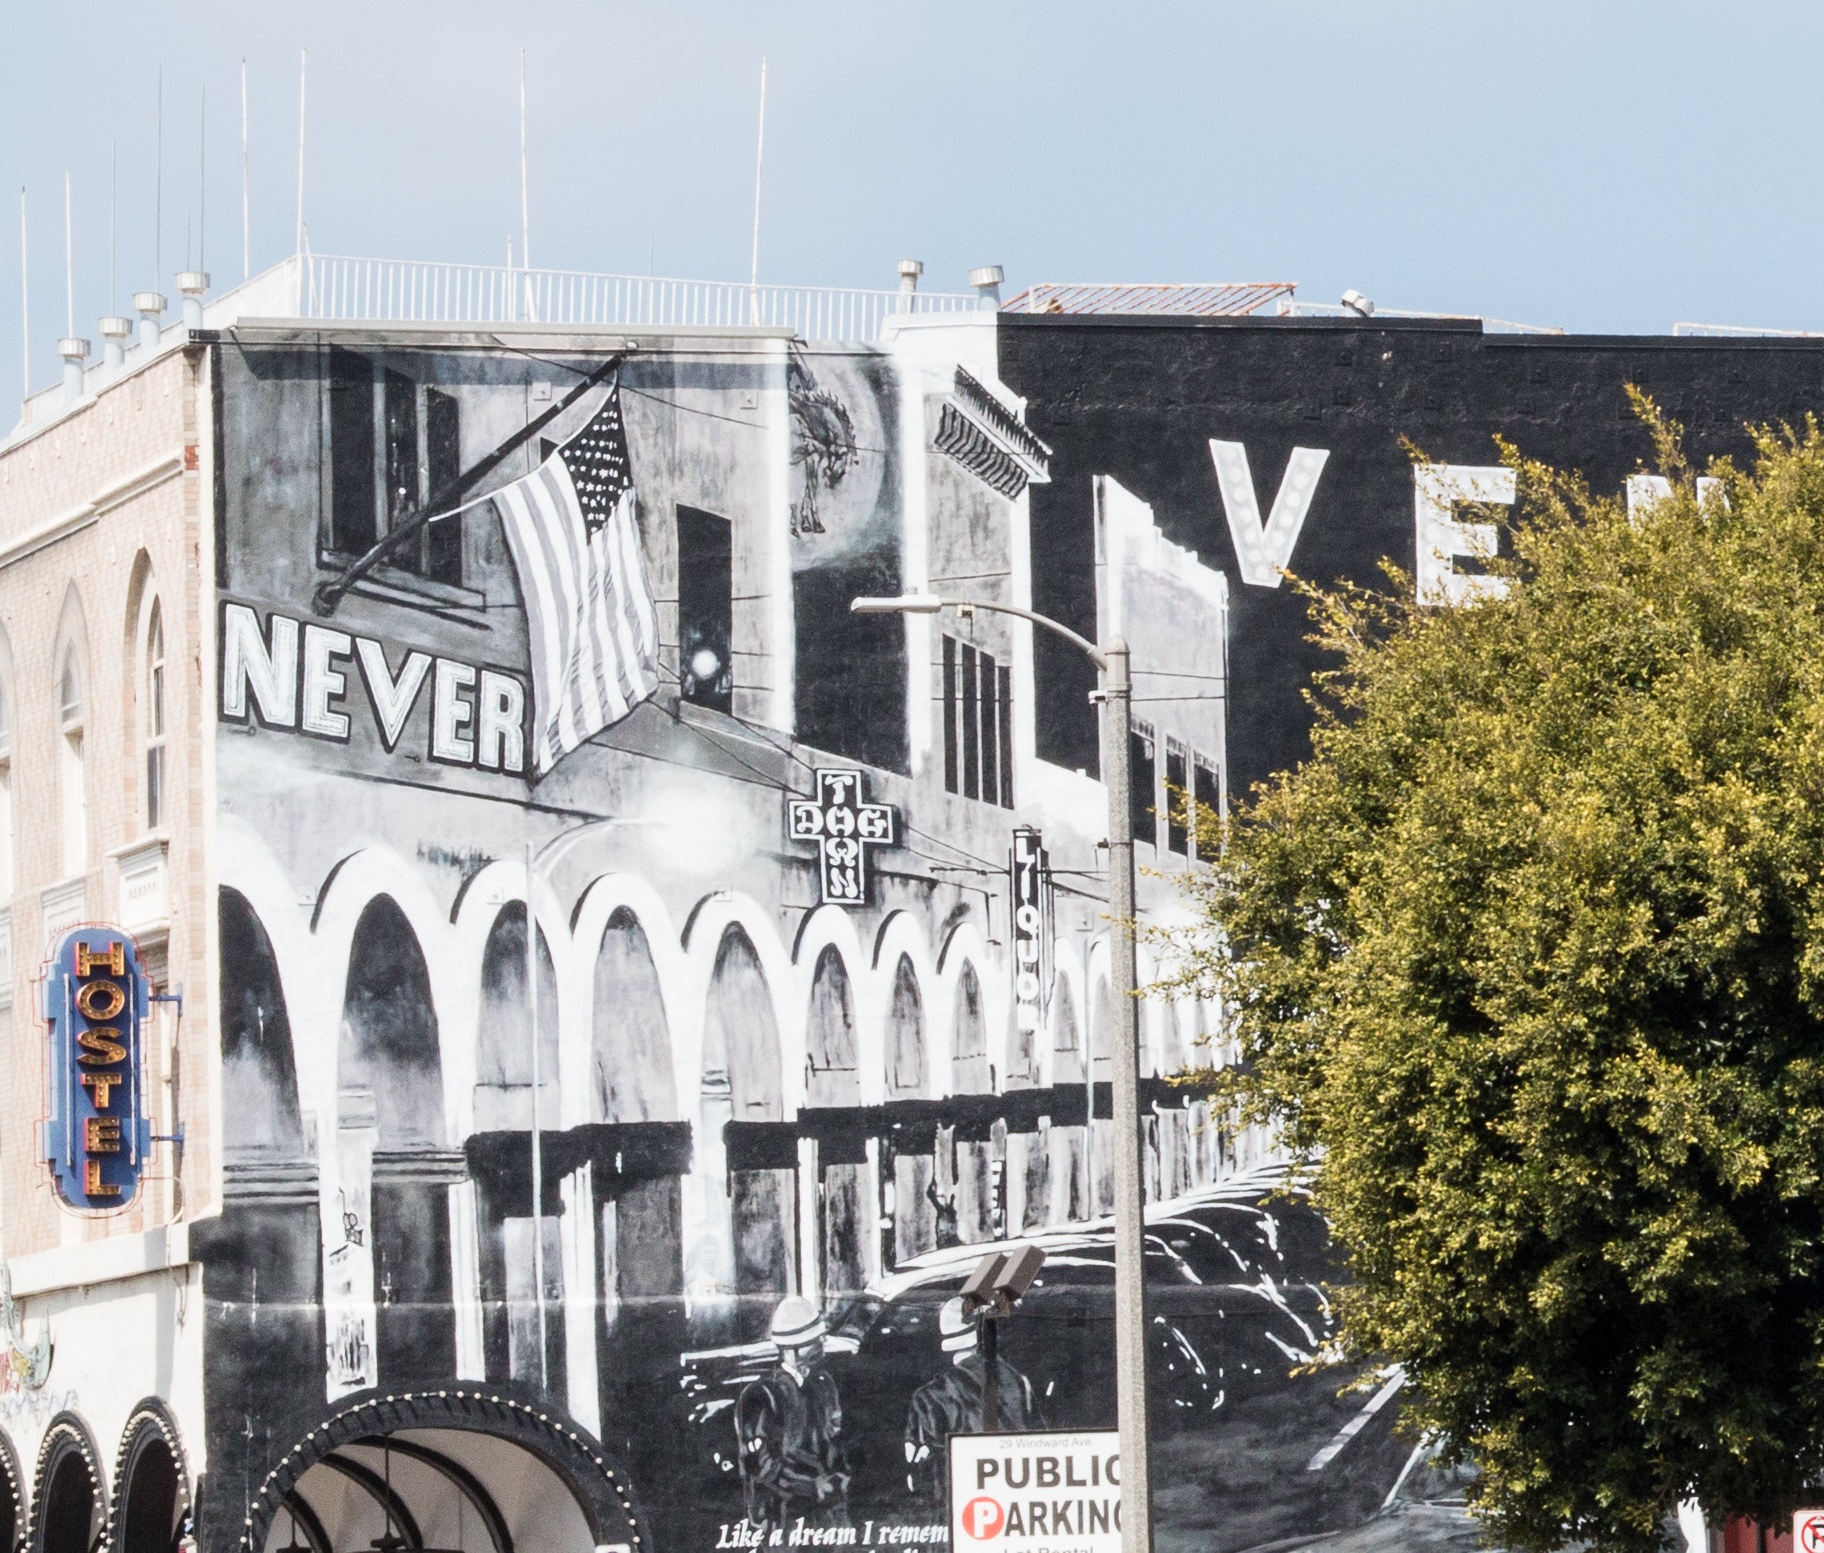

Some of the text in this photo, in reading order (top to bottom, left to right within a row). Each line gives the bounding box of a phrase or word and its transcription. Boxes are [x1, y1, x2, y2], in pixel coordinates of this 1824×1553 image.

[221, 601, 526, 774] NEVER
[75, 941, 127, 1196] HOSTEL
[1000, 1437, 1095, 1449] 29 Windward Ave.
[716, 1518, 764, 1549] Like
[769, 1529, 784, 1547] a
[789, 1517, 857, 1547] dream
[862, 1521, 874, 1546] I
[973, 1500, 1121, 1539] PARKIN
